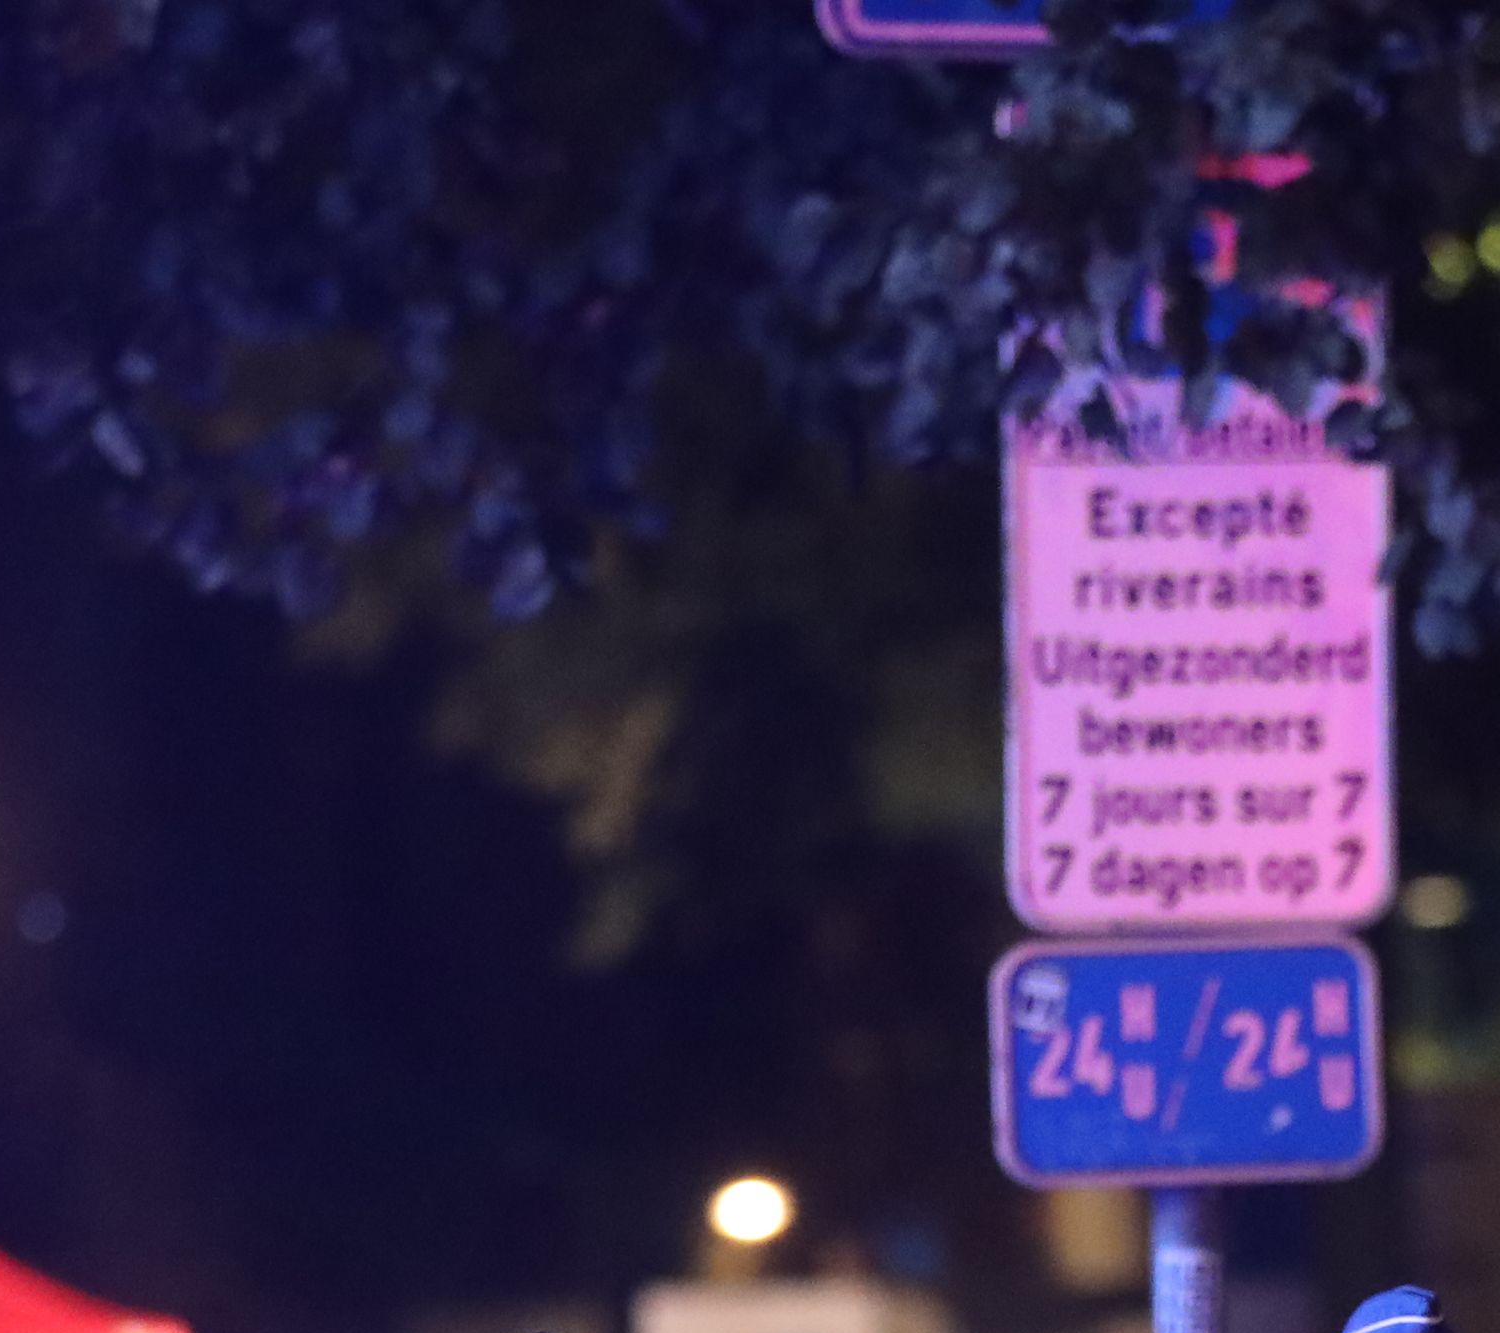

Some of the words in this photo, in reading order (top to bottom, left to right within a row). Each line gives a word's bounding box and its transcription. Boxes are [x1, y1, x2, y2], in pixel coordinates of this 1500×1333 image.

[1088, 486, 1312, 550] Excepté
[1075, 564, 1326, 610] riverains
[1033, 633, 1372, 697] Uitgezonderd
[1078, 705, 1325, 756] bewoners
[1040, 773, 1073, 825] 7
[1088, 777, 1218, 838] jours
[1238, 785, 1315, 825] sur
[1336, 769, 1368, 820] 7
[1042, 844, 1075, 893] 7
[1090, 847, 1246, 907] dagen
[1257, 855, 1319, 902] op
[1336, 836, 1366, 890] 7
